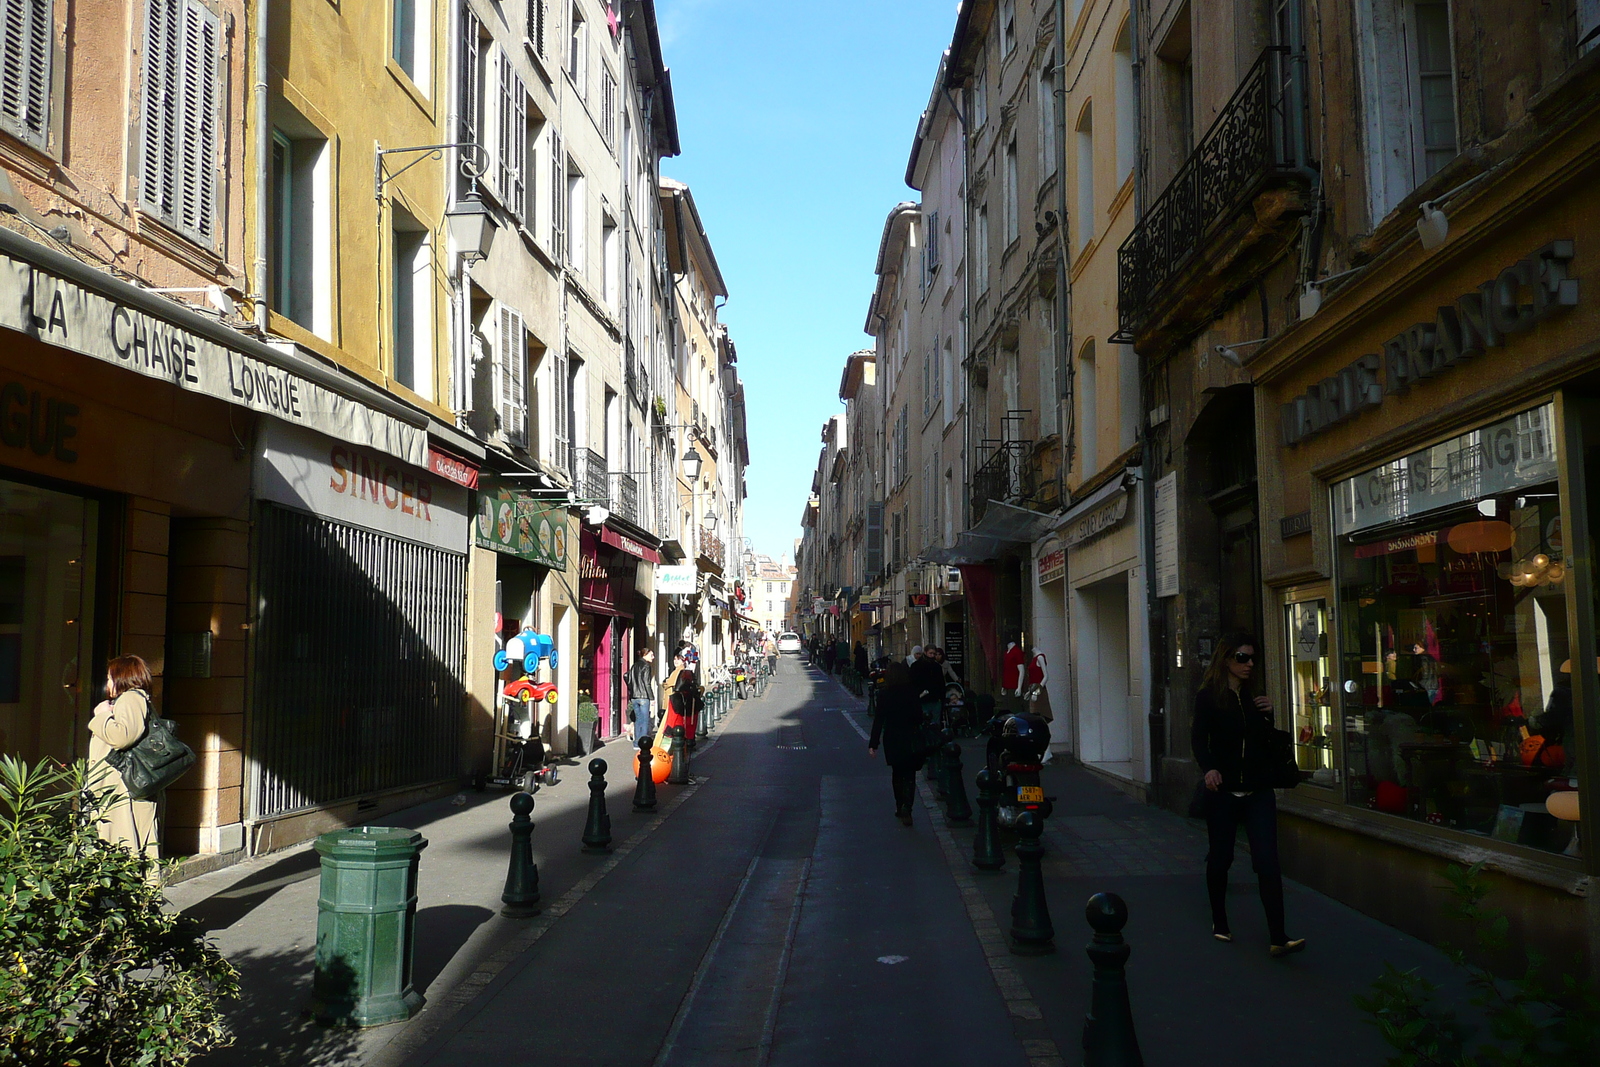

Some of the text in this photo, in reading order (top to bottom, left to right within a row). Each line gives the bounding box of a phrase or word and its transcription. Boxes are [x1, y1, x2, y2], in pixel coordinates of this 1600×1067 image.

[30, 270, 302, 418] LA CHAISE LONGUE
[1278, 239, 1579, 446] MARIE FRANCE
[330, 445, 432, 522] SINGER
[911, 594, 928, 605] V2
